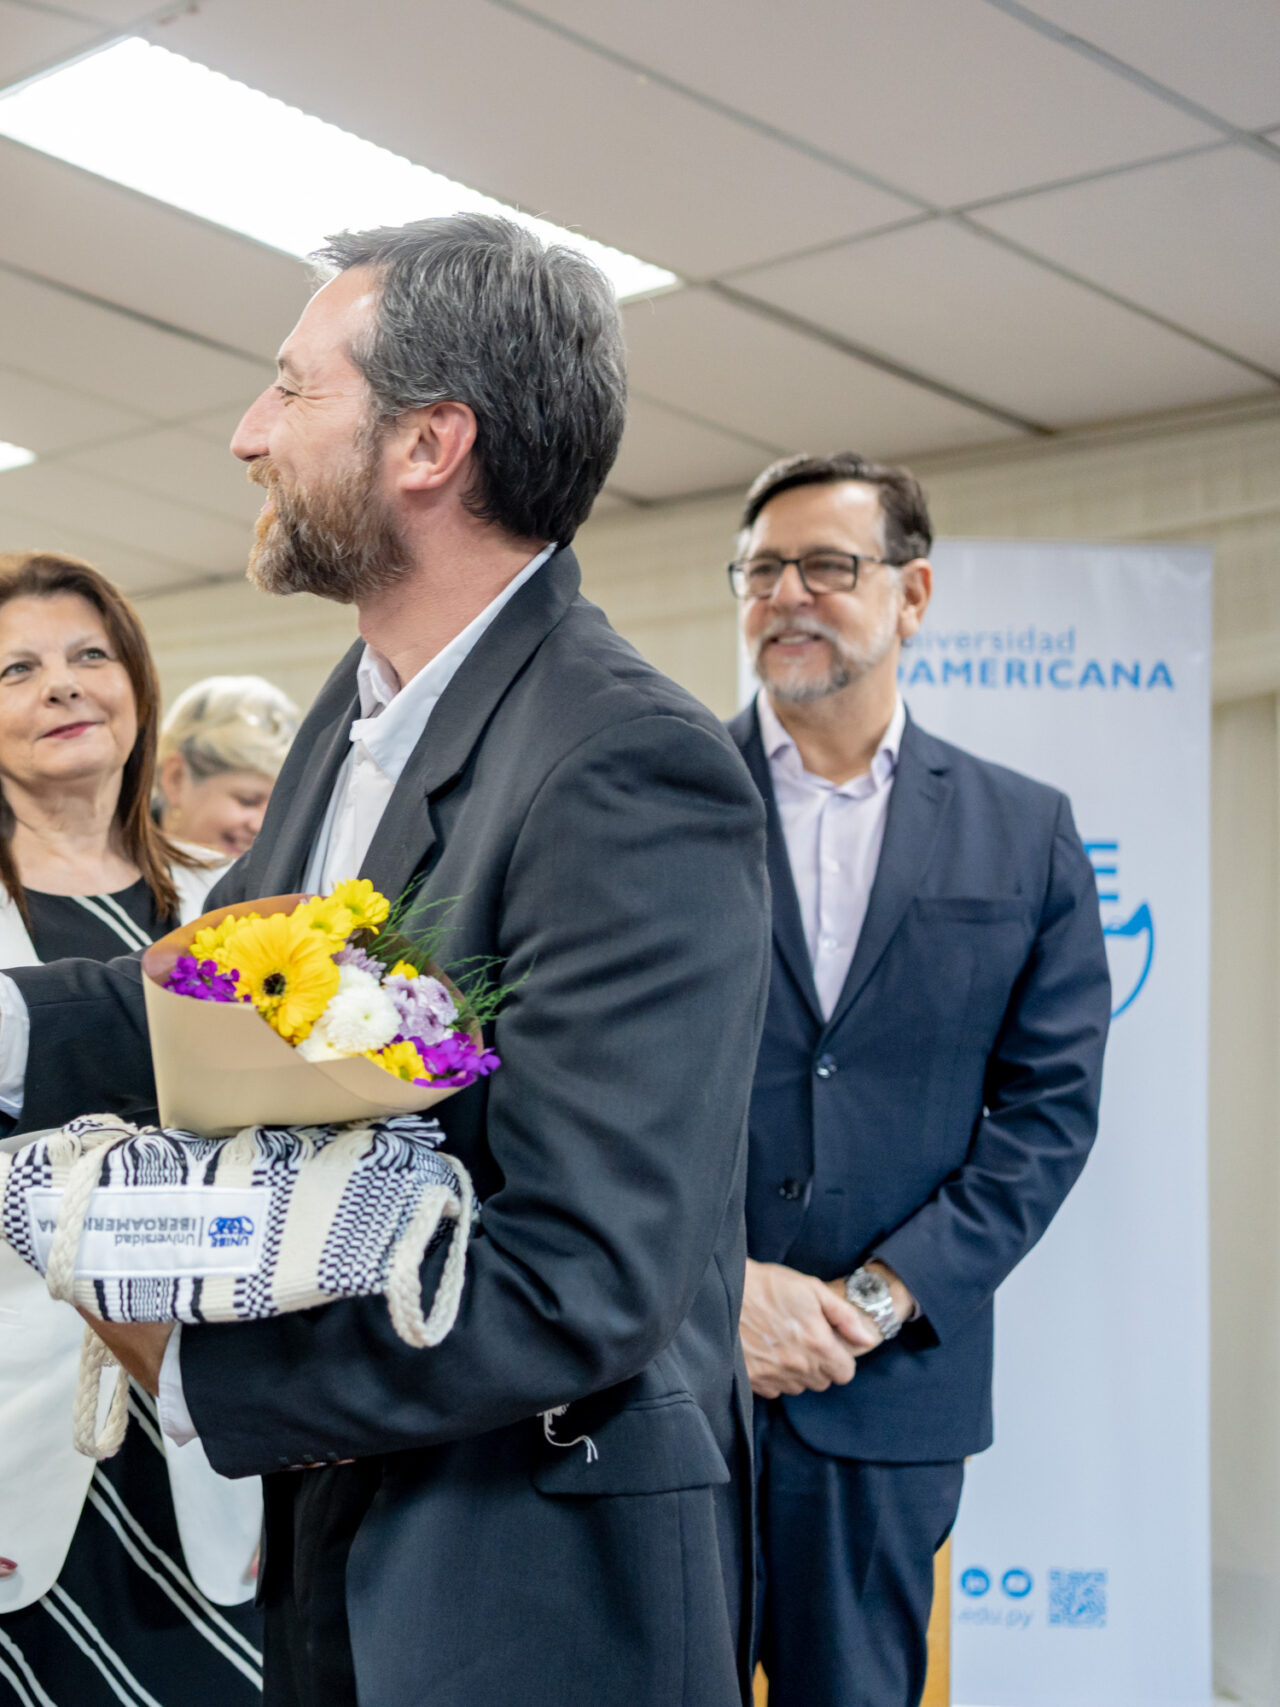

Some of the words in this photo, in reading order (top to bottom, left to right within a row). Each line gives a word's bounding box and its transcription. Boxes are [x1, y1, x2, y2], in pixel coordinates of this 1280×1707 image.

[896, 658, 1175, 690] AMERICANA
[37, 1217, 196, 1232] IBEROAMERIA
[114, 1233, 196, 1247] Universidad
